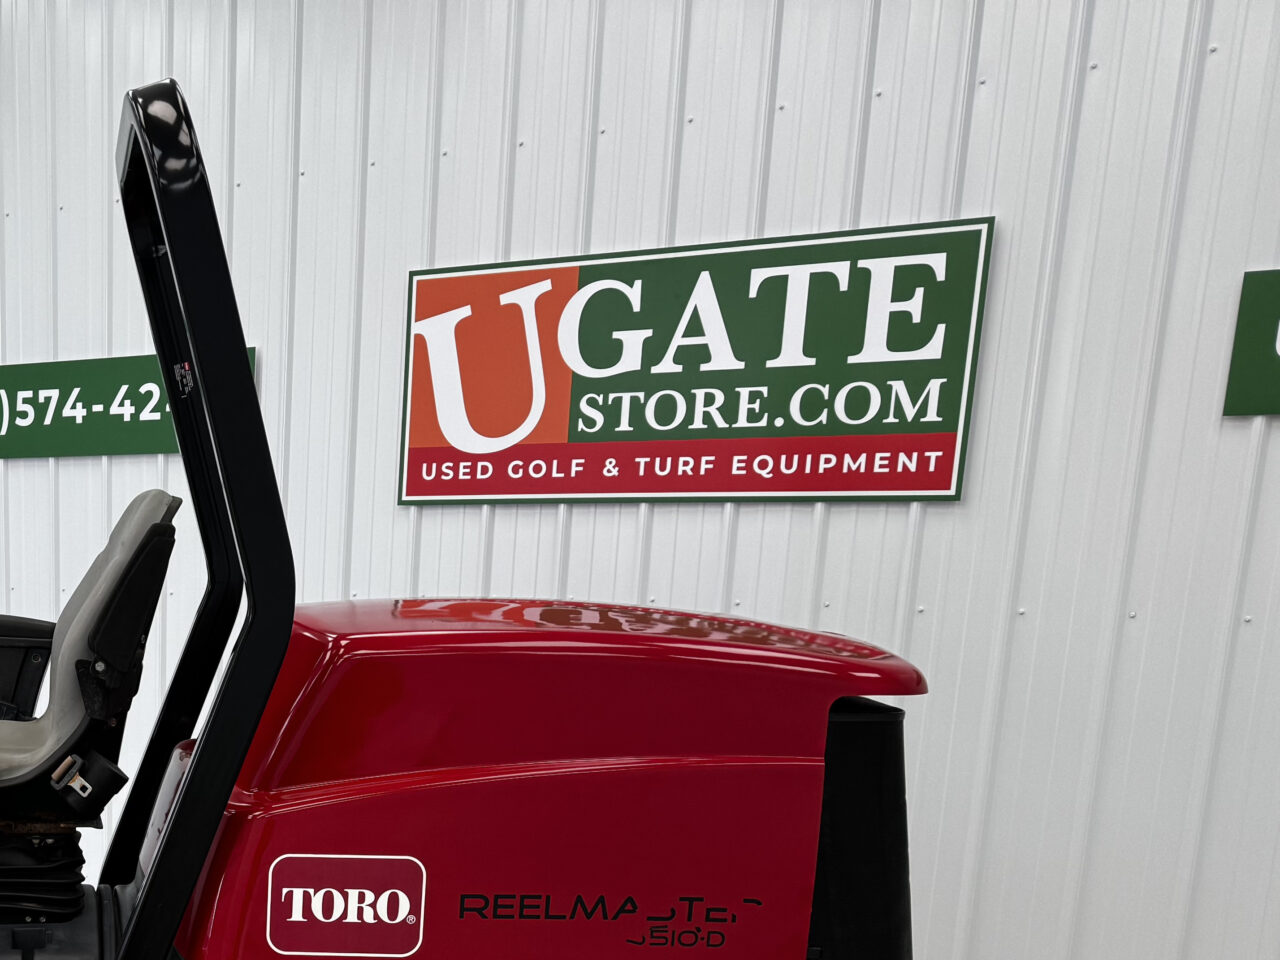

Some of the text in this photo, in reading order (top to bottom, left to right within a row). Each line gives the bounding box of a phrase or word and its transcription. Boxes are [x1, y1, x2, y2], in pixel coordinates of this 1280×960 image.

[577, 378, 948, 433] STORE.COM
[421, 450, 945, 481] USED GOLF & TURF EQUIPMENT
[281, 887, 410, 924] TORO
